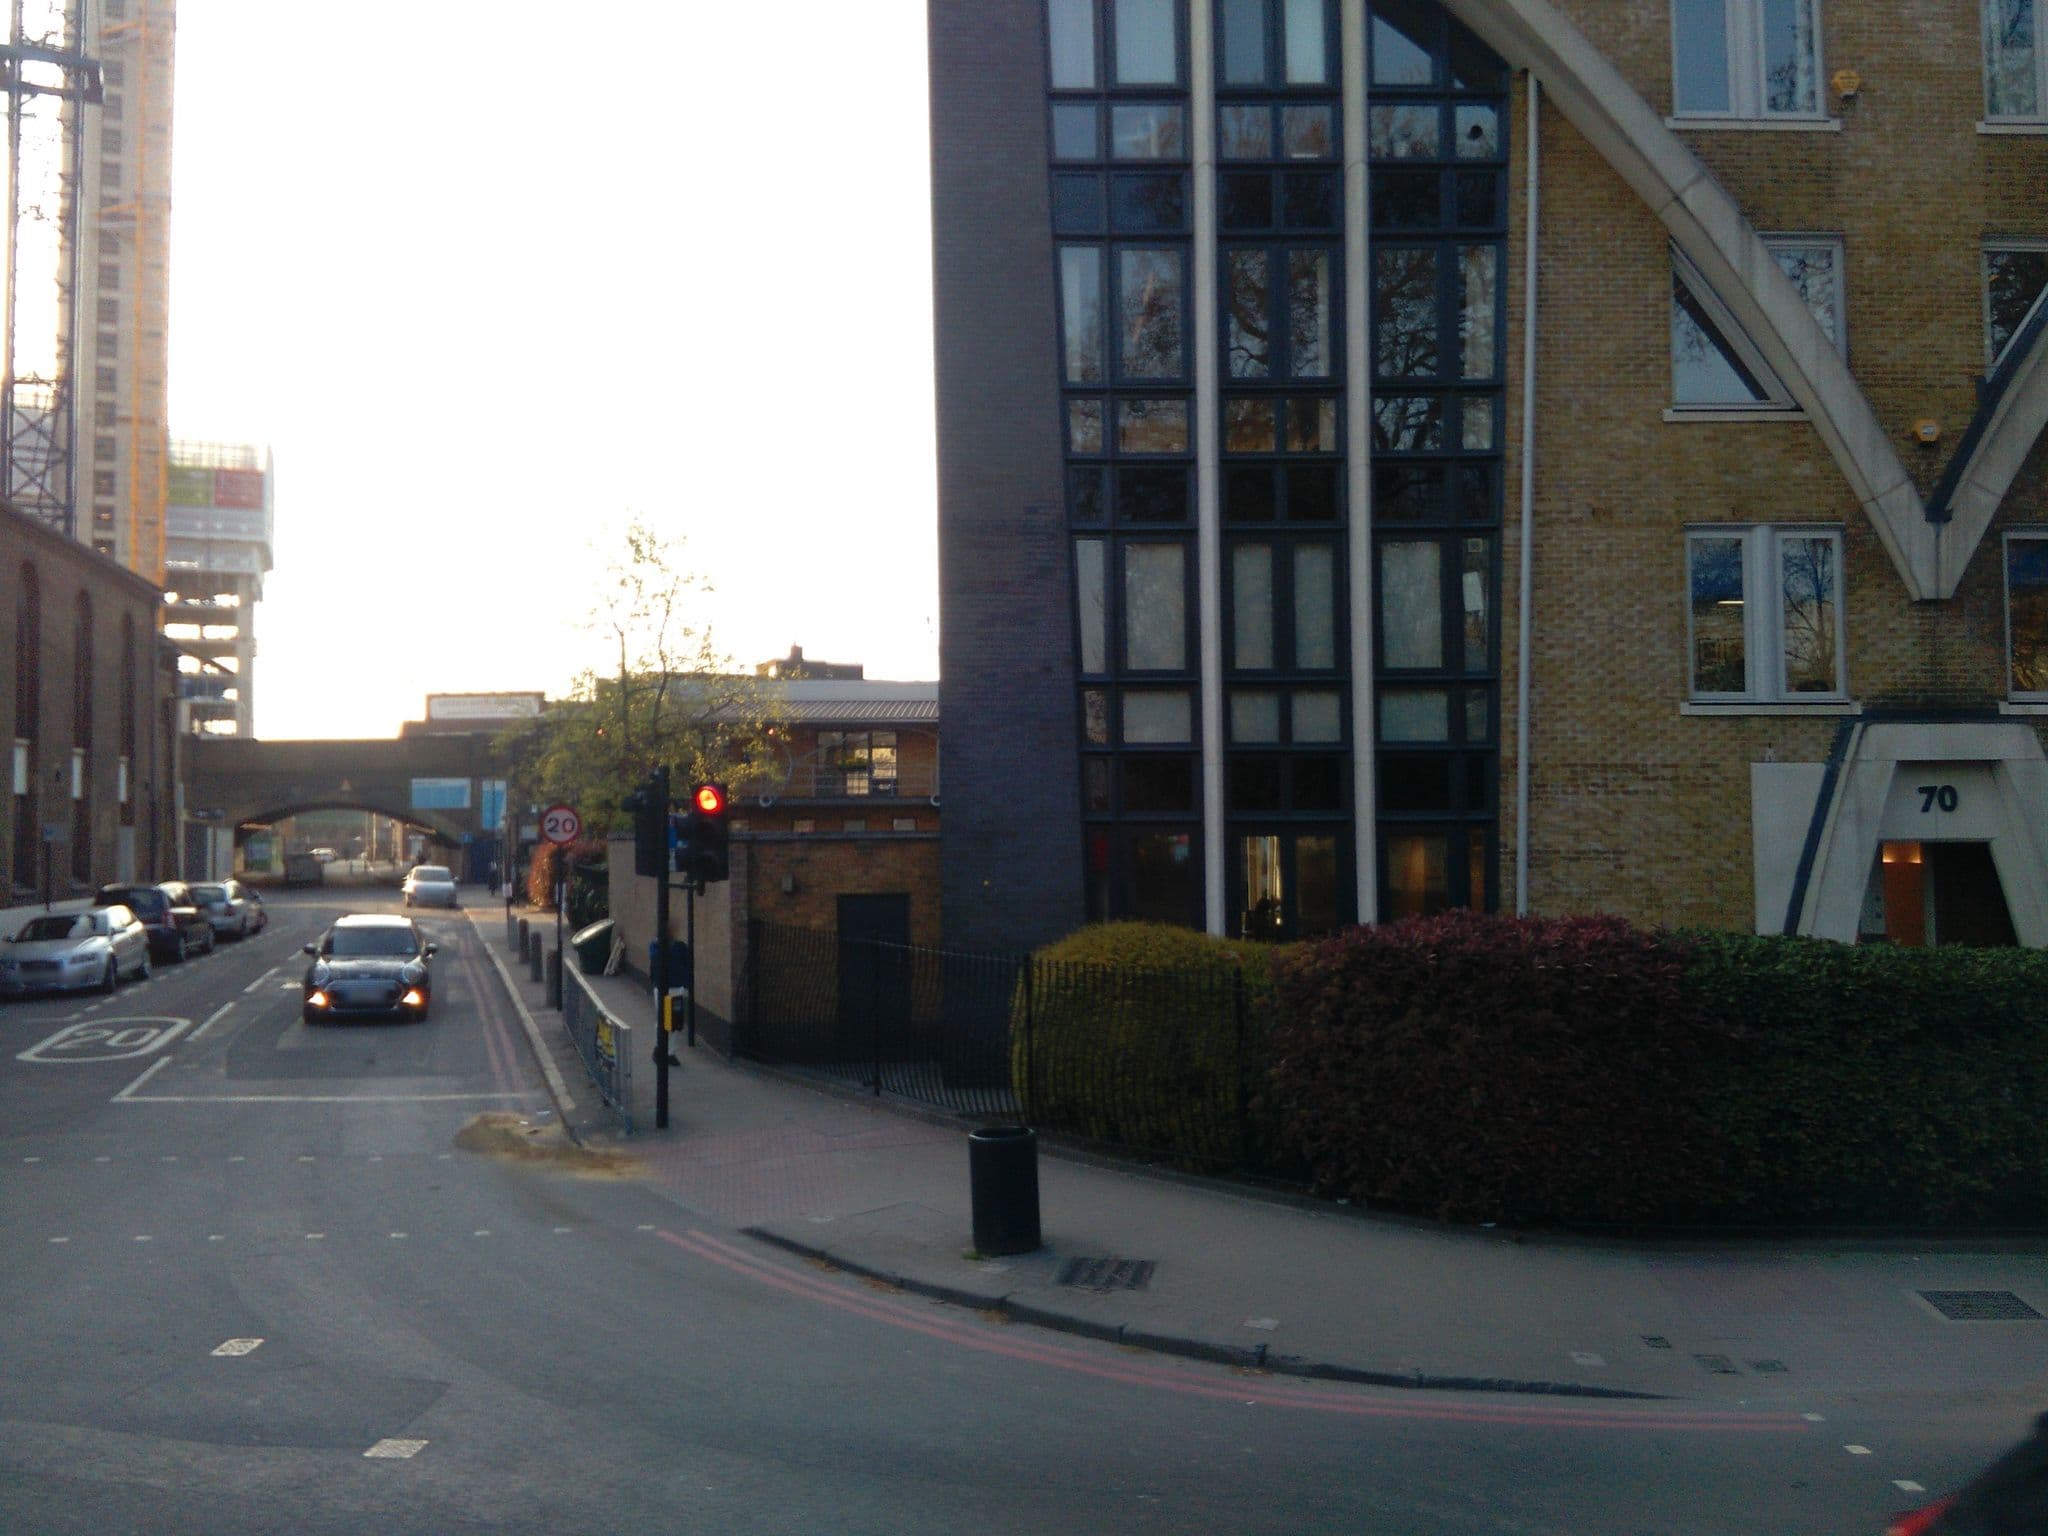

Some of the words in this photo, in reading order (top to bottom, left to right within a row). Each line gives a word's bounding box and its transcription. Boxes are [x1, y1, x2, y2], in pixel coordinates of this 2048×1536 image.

[1918, 784, 1958, 813] 70
[547, 817, 576, 833] 20
[52, 1028, 161, 1049] 20
